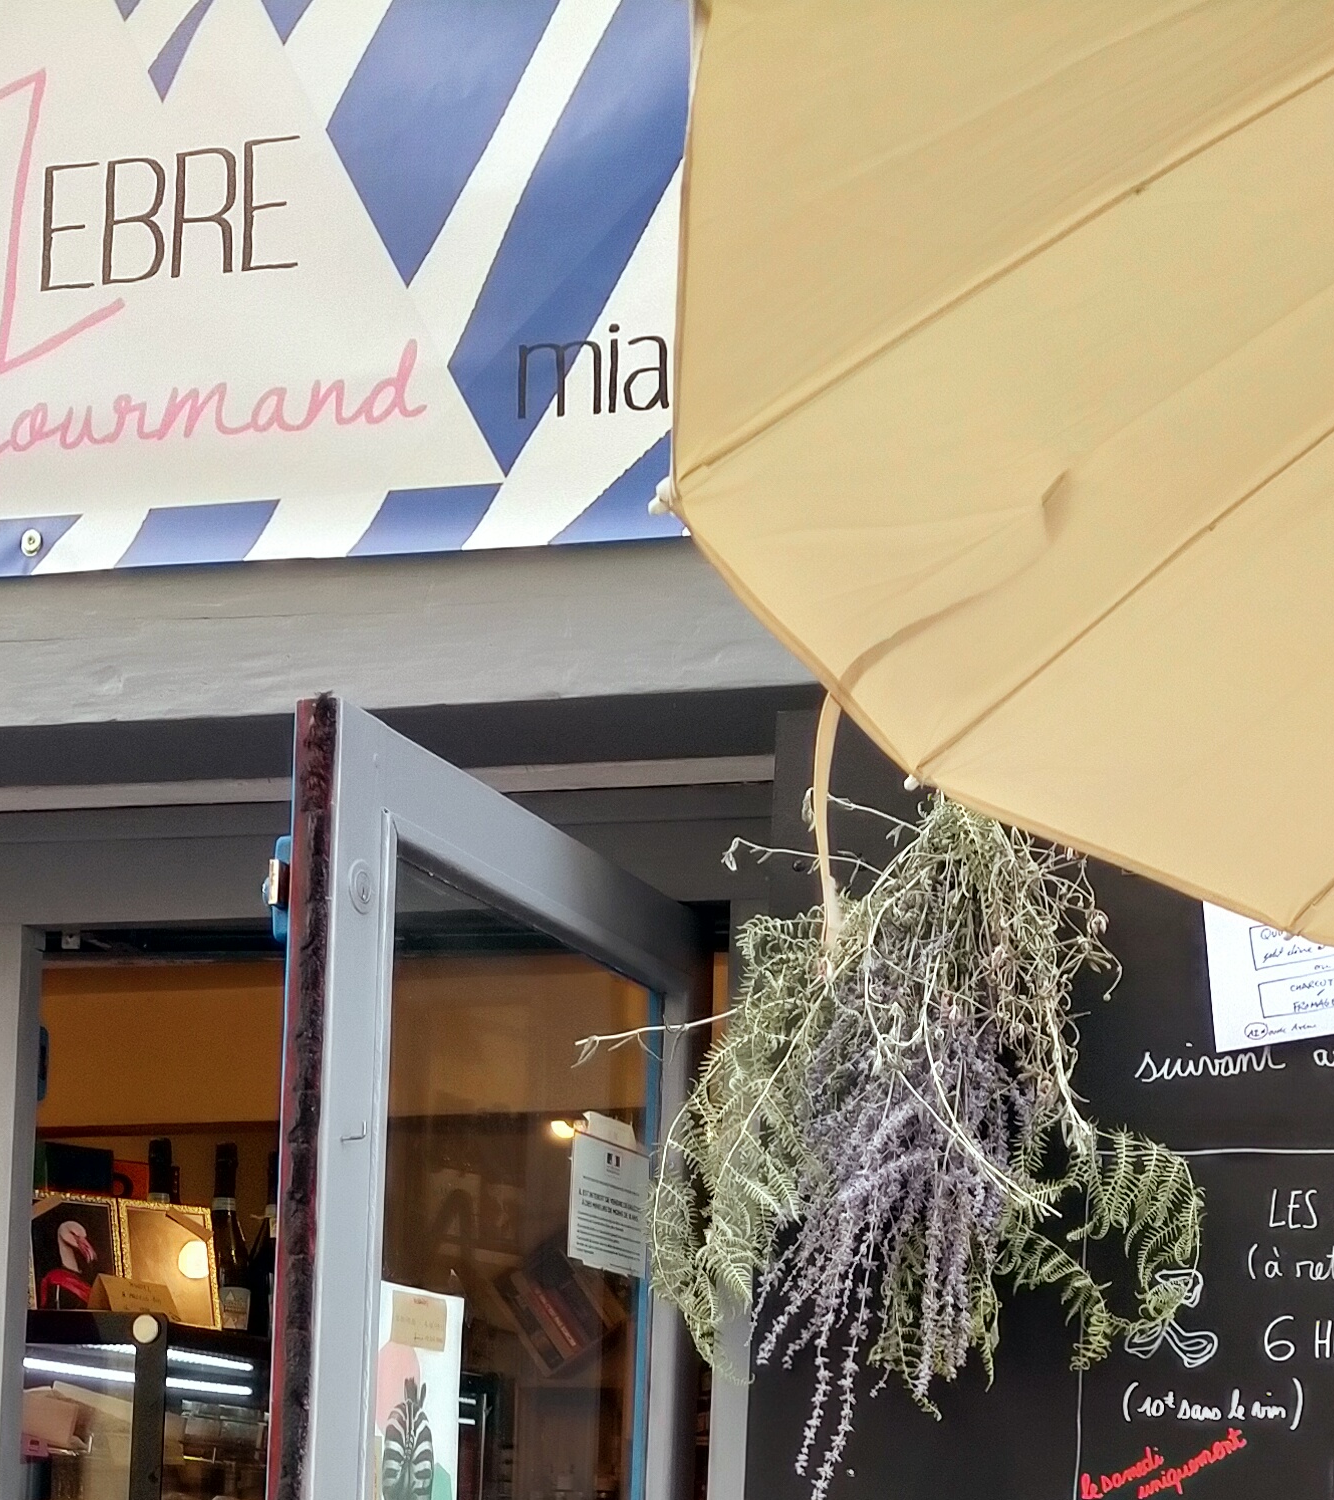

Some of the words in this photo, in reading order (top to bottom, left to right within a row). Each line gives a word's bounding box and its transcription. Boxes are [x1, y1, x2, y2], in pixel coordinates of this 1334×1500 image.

[517, 330, 669, 422] mia
[1267, 1185, 1320, 1232] LES
[1263, 1313, 1296, 1363] 6
[1101, 1446, 1164, 1493] samedi
[1137, 1426, 1247, 1500] uniquement
